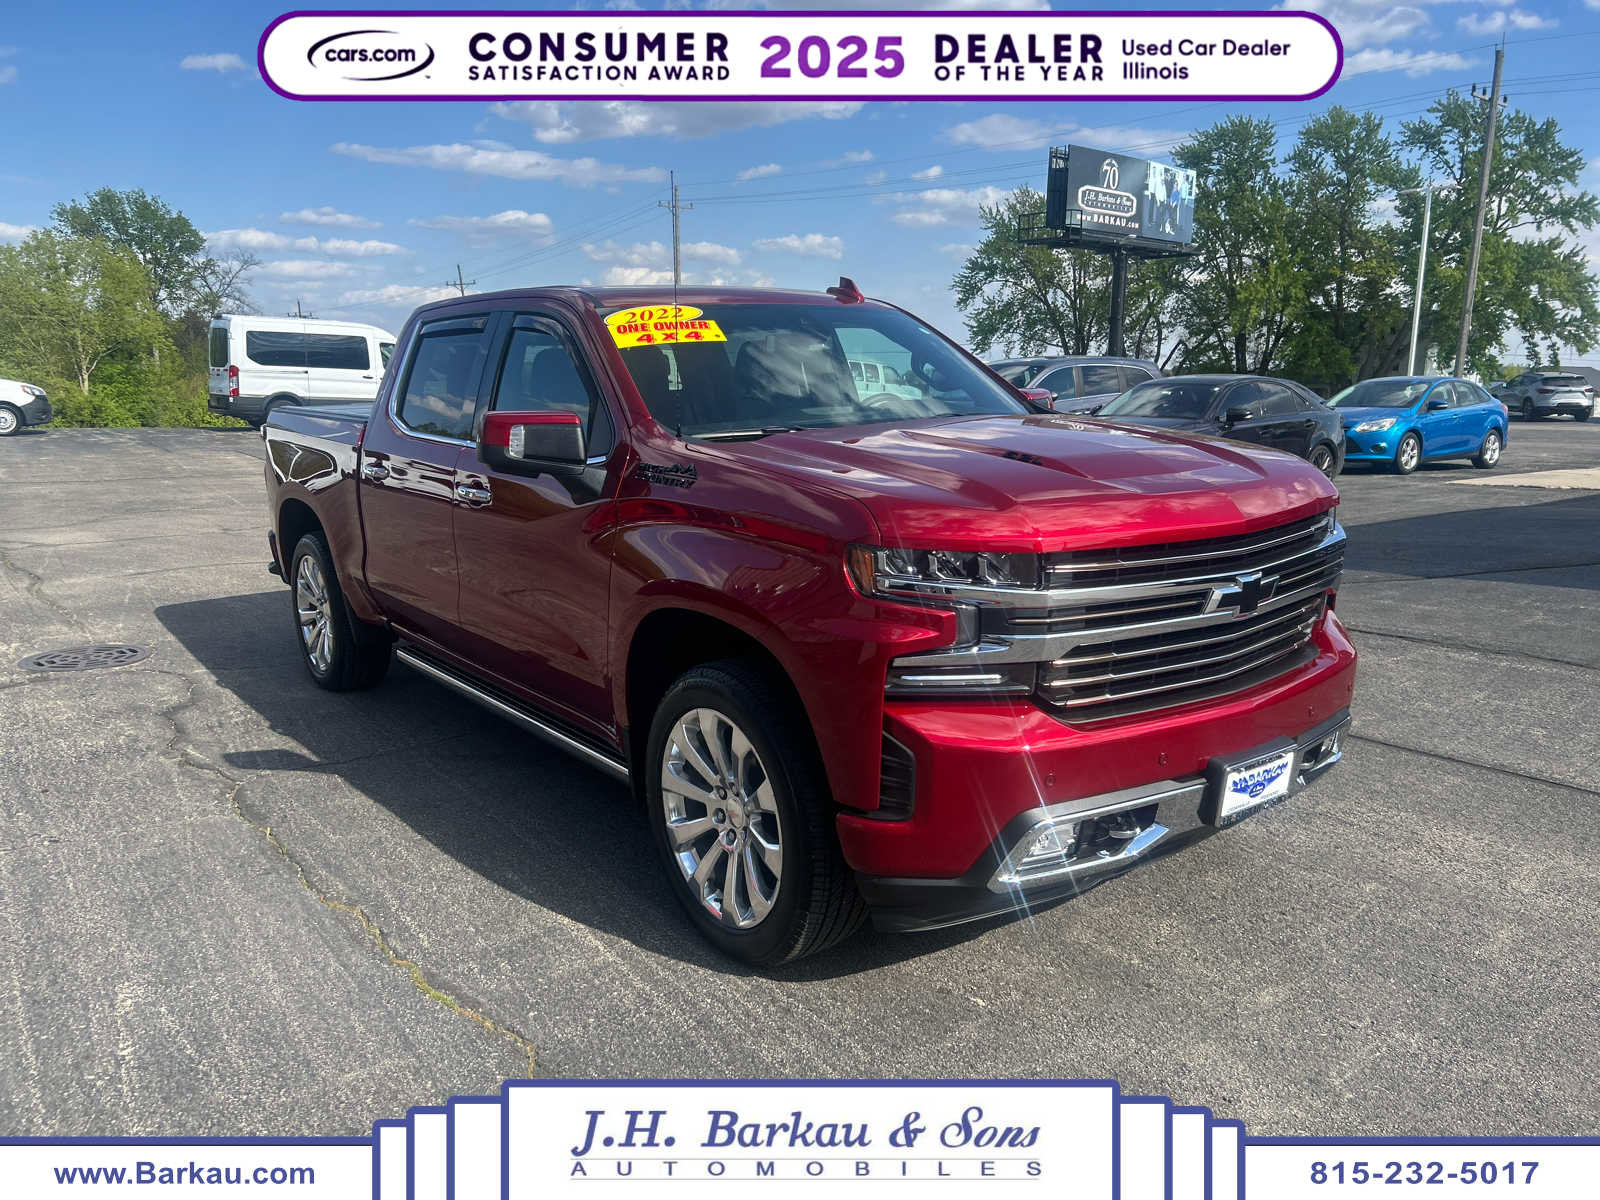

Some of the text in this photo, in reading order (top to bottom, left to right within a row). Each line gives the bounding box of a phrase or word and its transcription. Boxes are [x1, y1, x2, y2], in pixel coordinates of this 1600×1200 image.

[1102, 165, 1119, 190] 70
[624, 307, 684, 324] 2022
[616, 321, 711, 335] ONE OWNER
